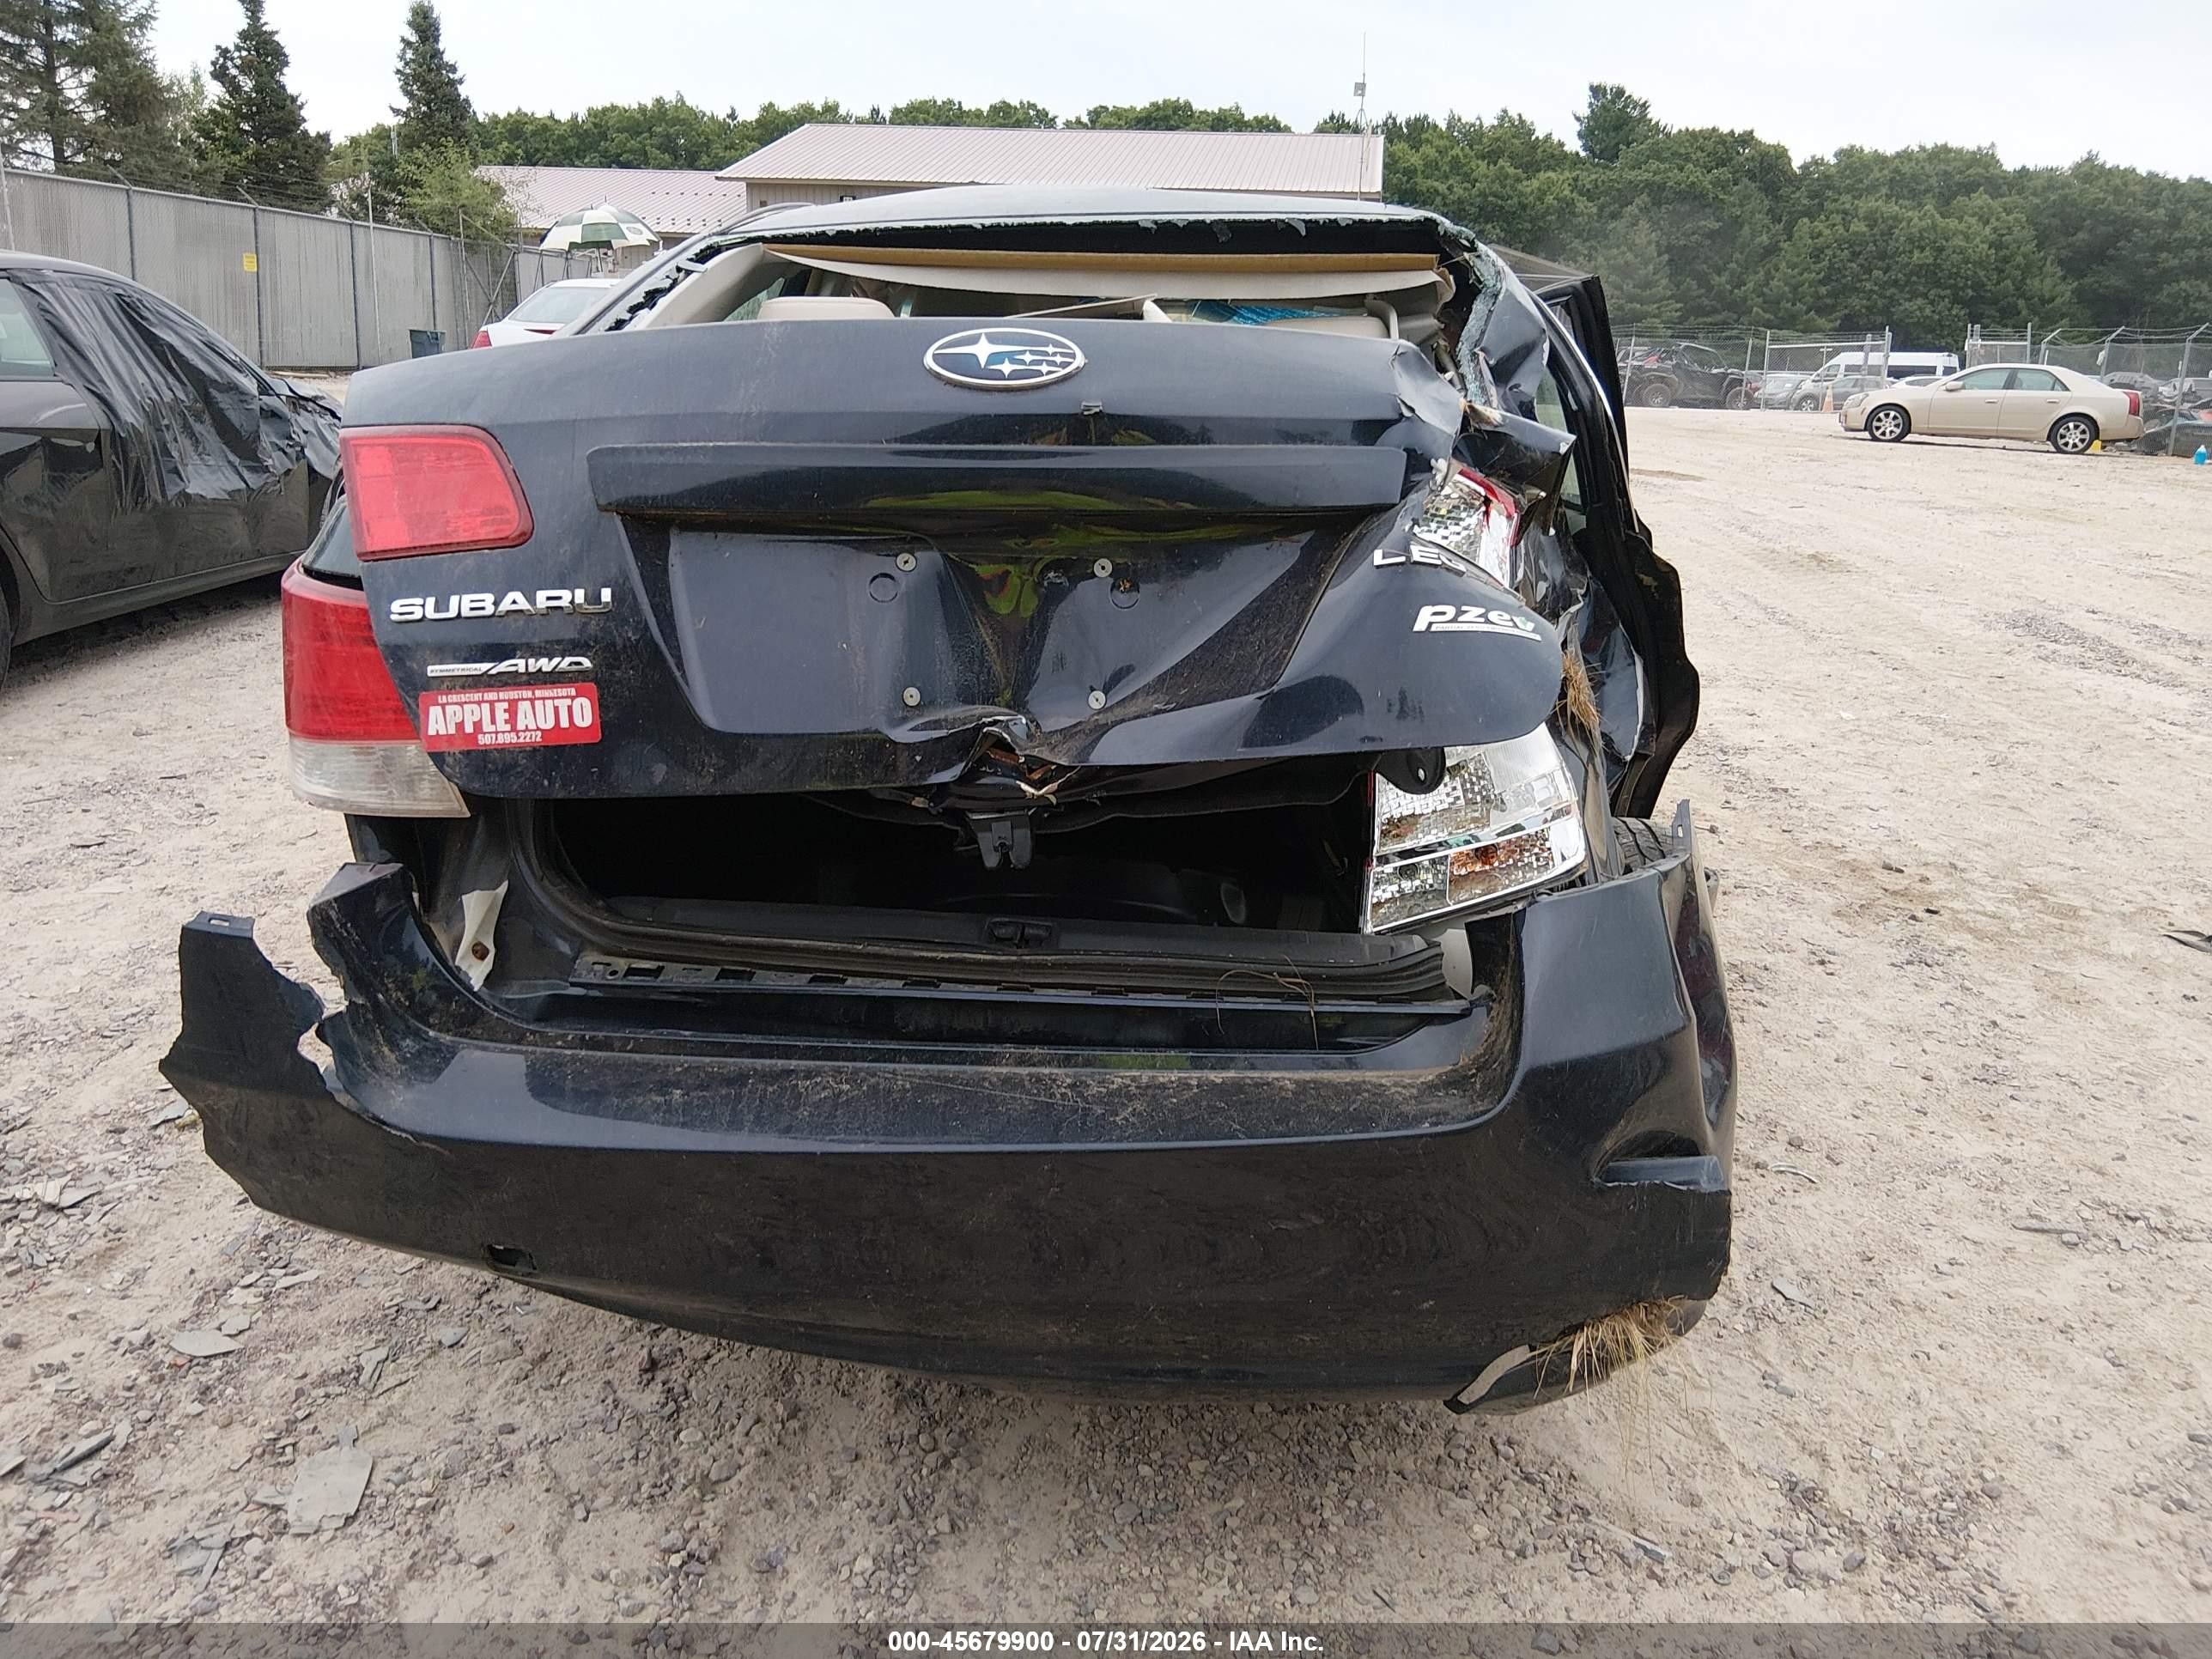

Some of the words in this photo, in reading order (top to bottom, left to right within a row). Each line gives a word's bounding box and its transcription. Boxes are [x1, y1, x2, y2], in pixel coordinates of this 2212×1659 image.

[390, 587, 612, 623] SUBARU
[487, 656, 594, 675] AWD
[438, 695, 447, 703] LA
[447, 692, 483, 703] CRESCENT
[483, 691, 498, 701] AND
[534, 688, 577, 698] MINNESOTA
[428, 702, 512, 736] APPLE
[516, 696, 593, 731] AUTO
